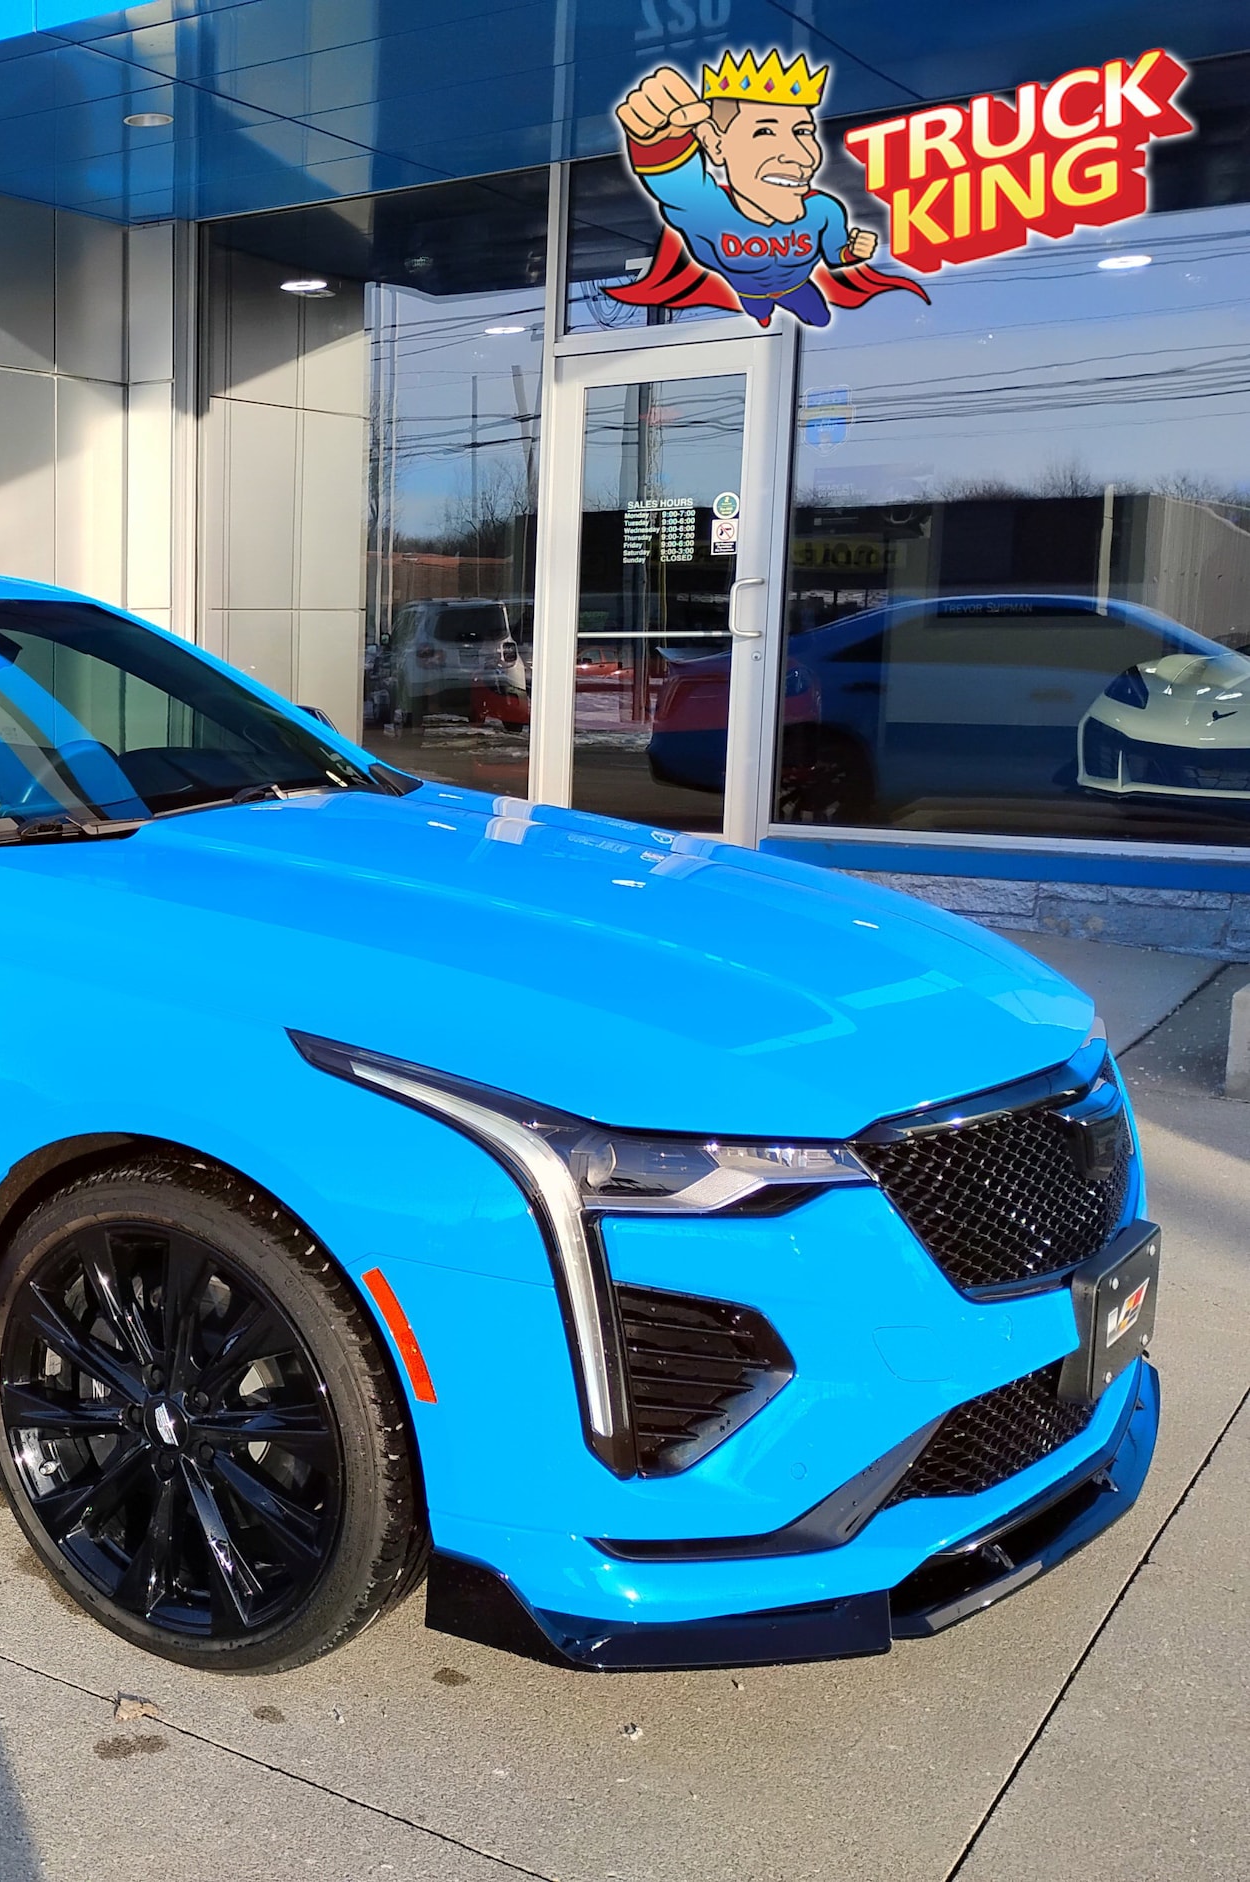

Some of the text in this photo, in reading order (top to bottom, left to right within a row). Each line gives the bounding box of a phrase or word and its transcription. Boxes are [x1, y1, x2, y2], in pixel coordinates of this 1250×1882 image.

[627, 497, 694, 510] SALES HOURS
[624, 512, 650, 520] Monday
[623, 519, 650, 527] Tuesday
[623, 527, 660, 535] Wednesday
[623, 534, 652, 542] Thursday
[623, 542, 643, 550] Friday
[622, 549, 651, 557] Saturday
[622, 554, 693, 565] Sunday CLOSED
[942, 603, 982, 614] TREVOR
